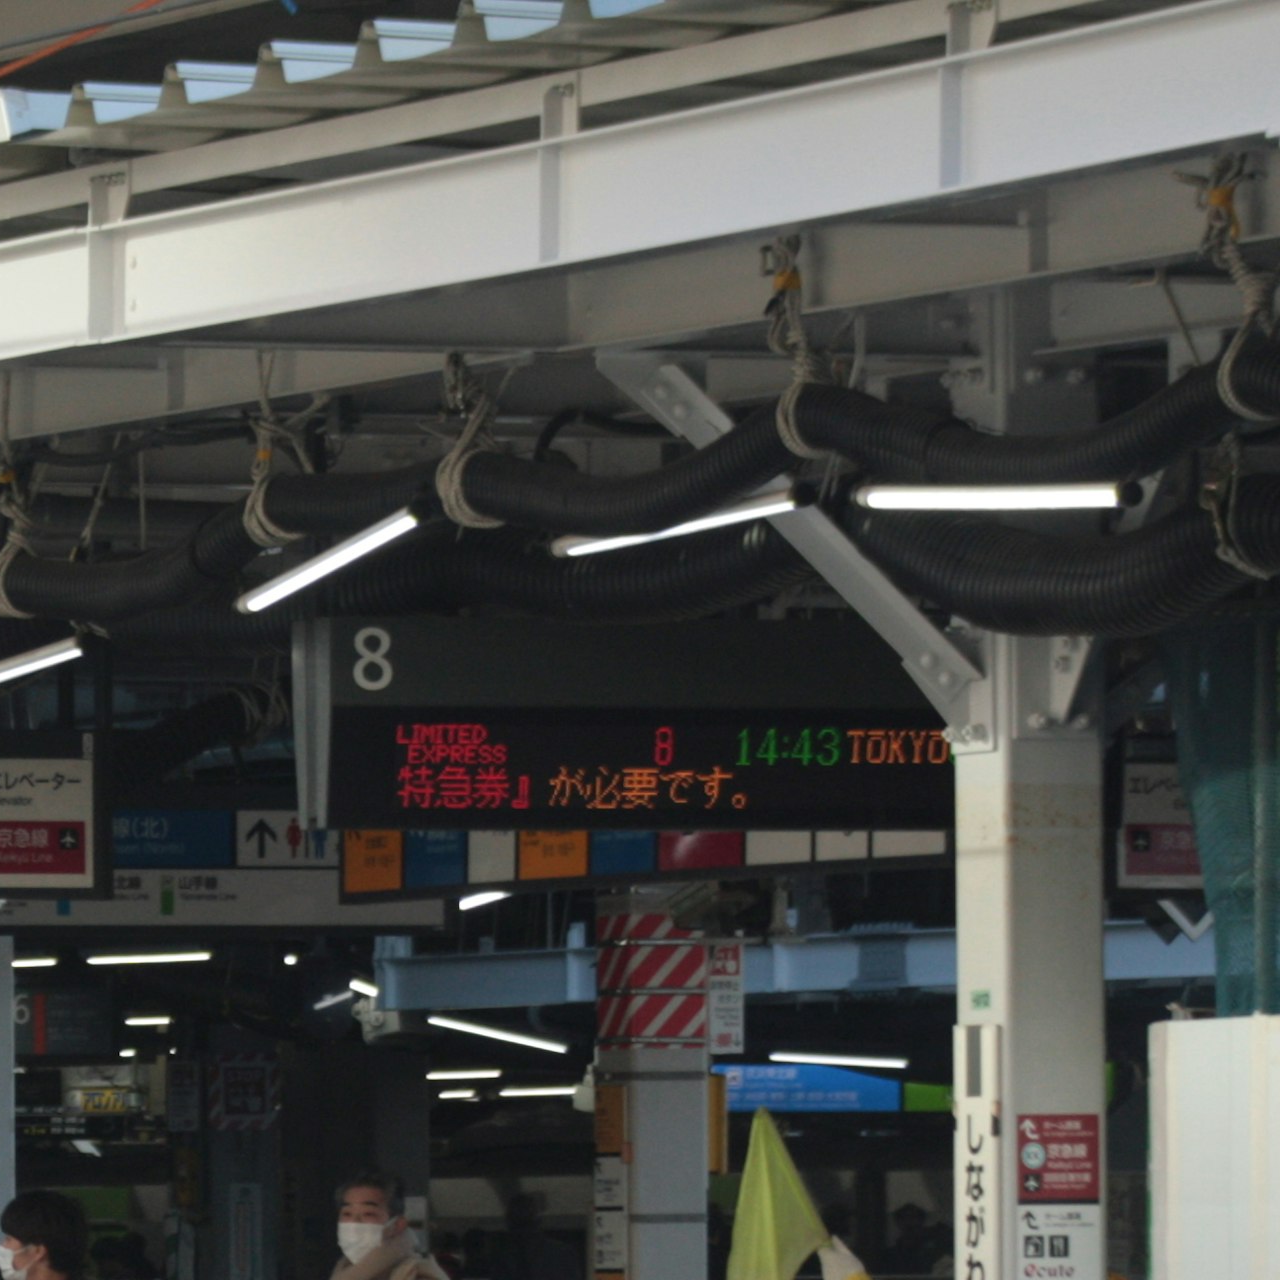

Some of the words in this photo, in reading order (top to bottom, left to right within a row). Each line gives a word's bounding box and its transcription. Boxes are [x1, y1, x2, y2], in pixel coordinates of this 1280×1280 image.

[353, 627, 393, 691] 8
[395, 722, 489, 745] LIMITED
[406, 744, 508, 764] EXPRESS
[654, 726, 674, 766] 8
[736, 727, 840, 766] 14:43
[1024, 1263, 1075, 1278] ecute
